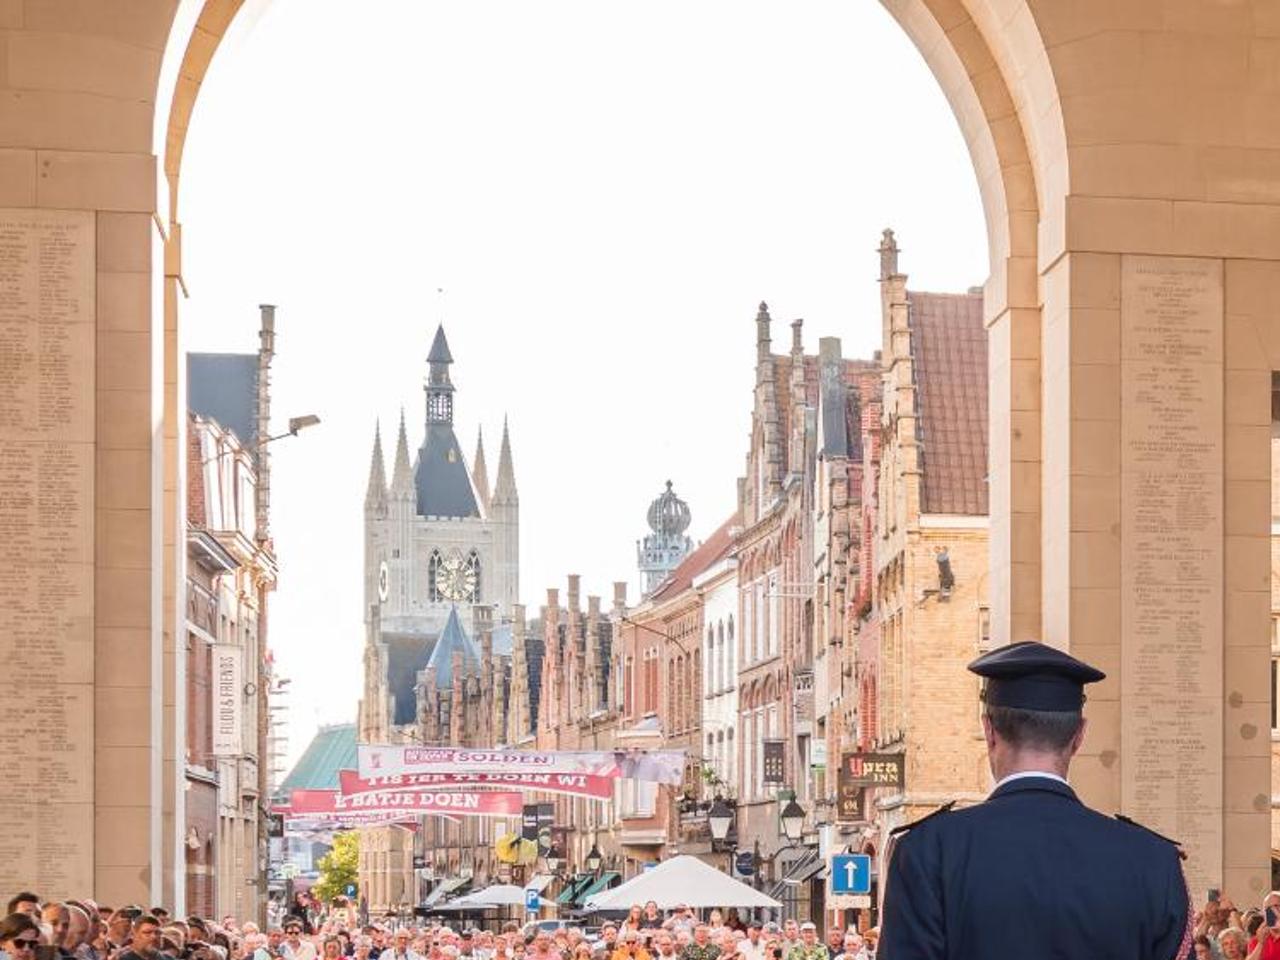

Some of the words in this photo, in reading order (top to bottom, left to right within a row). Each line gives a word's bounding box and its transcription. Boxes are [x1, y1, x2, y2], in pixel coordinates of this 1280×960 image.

[458, 751, 548, 764] SOLDEN
[487, 773, 551, 784] DOEN
[557, 775, 587, 787] WI
[873, 772, 899, 783] INN
[352, 793, 415, 807] BATJE
[419, 792, 481, 808] DOEN
